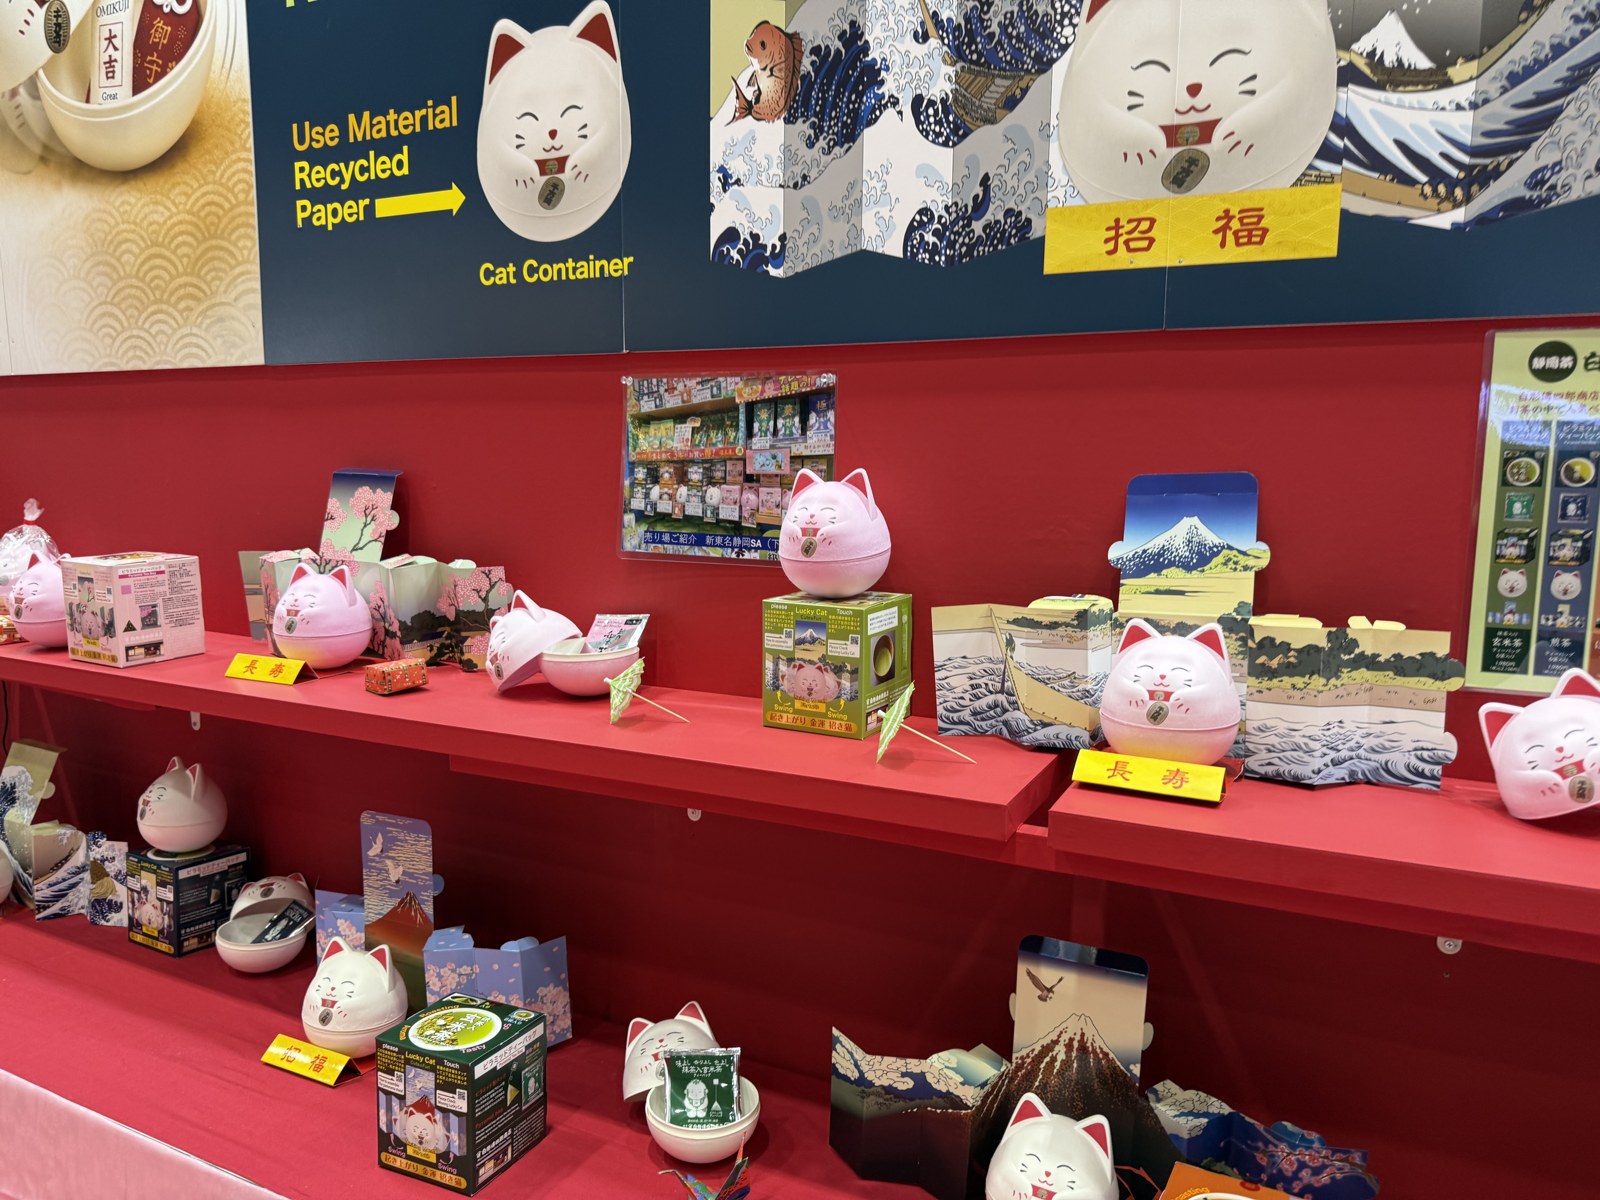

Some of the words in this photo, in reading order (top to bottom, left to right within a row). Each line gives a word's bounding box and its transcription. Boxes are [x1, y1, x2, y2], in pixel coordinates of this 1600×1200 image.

[96, 0, 130, 18] OMIKUJI
[103, 28, 120, 81] 大吉
[144, 17, 171, 83] 御守
[101, 91, 119, 101] Great
[292, 121, 340, 151] Use
[347, 95, 458, 143] Material
[294, 145, 409, 190] Recycled
[296, 198, 370, 230] Paper
[479, 262, 517, 286] Cat
[523, 255, 634, 283] Container
[644, 532, 697, 544] 売り場ご紹介
[795, 607, 814, 616] Lucky
[816, 608, 828, 616] Cat
[836, 608, 853, 616] Touch
[242, 659, 286, 678] 長寿
[774, 703, 793, 713] Swing
[827, 711, 848, 720] Swing
[769, 713, 806, 725] 起き上がり
[829, 721, 852, 732] 招き猫
[1106, 760, 1190, 789] 長寿
[382, 1043, 399, 1052] please
[280, 1045, 329, 1073] 招福
[405, 1051, 424, 1062] Lucky
[424, 1056, 436, 1065] Cat
[443, 1060, 460, 1069] Touch
[388, 1146, 406, 1158] Swing
[438, 1162, 457, 1174] Swing
